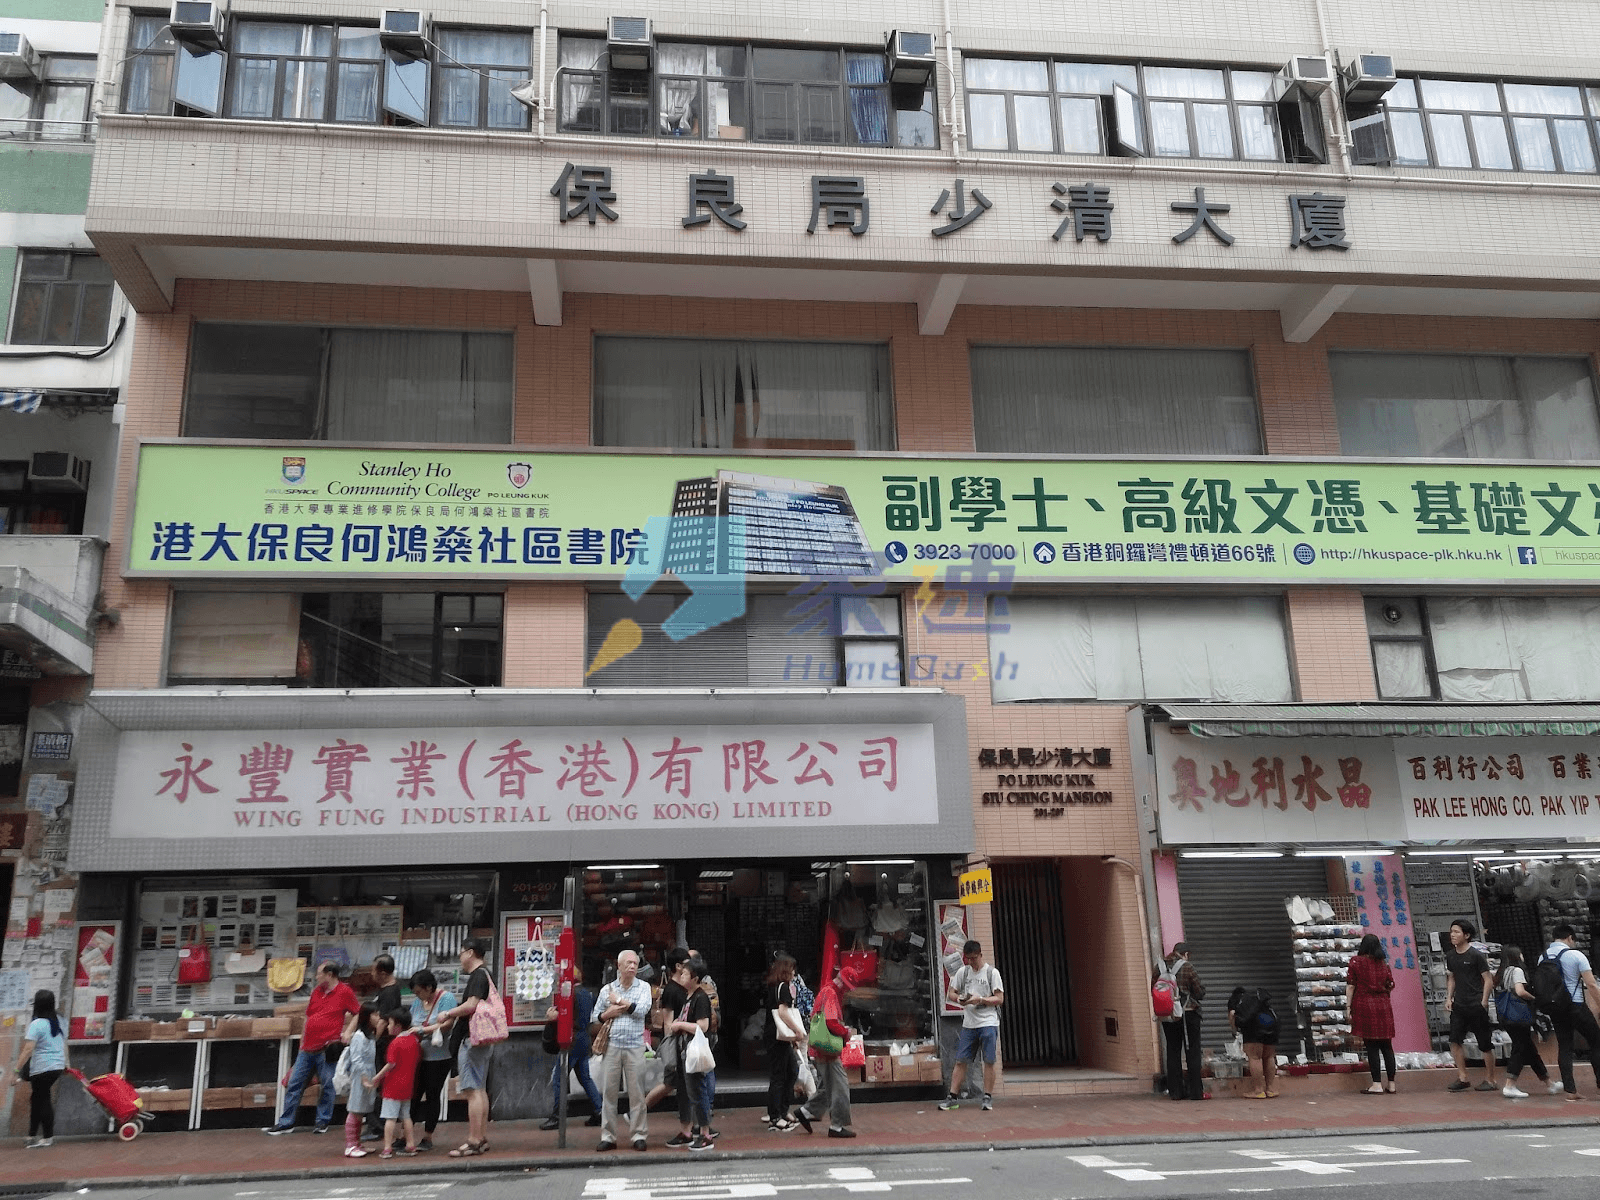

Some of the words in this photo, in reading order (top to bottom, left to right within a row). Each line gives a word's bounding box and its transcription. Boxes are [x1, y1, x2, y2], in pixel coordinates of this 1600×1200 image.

[550, 162, 1352, 250] 保良局少清大廈
[359, 461, 421, 480] Stanley
[425, 463, 451, 478] Ho
[327, 480, 421, 500] Community
[425, 482, 481, 502] College
[264, 503, 550, 518] 香港大學專業進修學院保良局何鴻燊社區書院
[882, 475, 1600, 537] 副學士、高級文憑、基礎文
[150, 522, 650, 565] 港大保良何鴻燊社區書院
[913, 544, 962, 560] 3923
[967, 544, 1016, 560] 7000
[1062, 542, 1277, 563] 香港銅鑼灣禮頓道66號
[1321, 548, 1503, 562] http://hkuspace-plk.hku.hk
[978, 747, 1112, 768] 保良局少清大廈
[1407, 753, 1526, 781] 百利行公司
[1547, 752, 1600, 780] 百業
[155, 736, 900, 803] 永豐實業(香港)有限公司
[998, 774, 1016, 788] PO
[1018, 774, 1063, 787] LEUNG
[1065, 774, 1095, 787] KUK
[982, 792, 1004, 805] SIU
[1006, 791, 1050, 804] CHING
[1052, 791, 1113, 804] MANSION
[1413, 797, 1440, 818] PAK
[1443, 797, 1468, 818] LEE
[1471, 796, 1508, 817] HONG
[1512, 795, 1534, 816] CO.
[1540, 795, 1567, 816] PAK
[1569, 795, 1590, 816] YIP
[233, 809, 302, 828] WING
[319, 808, 386, 827] FUNG
[401, 805, 551, 825] INDUSTRIAL
[567, 803, 638, 823] (HONG
[653, 802, 720, 821] KONG)
[733, 801, 832, 819] LIMITED
